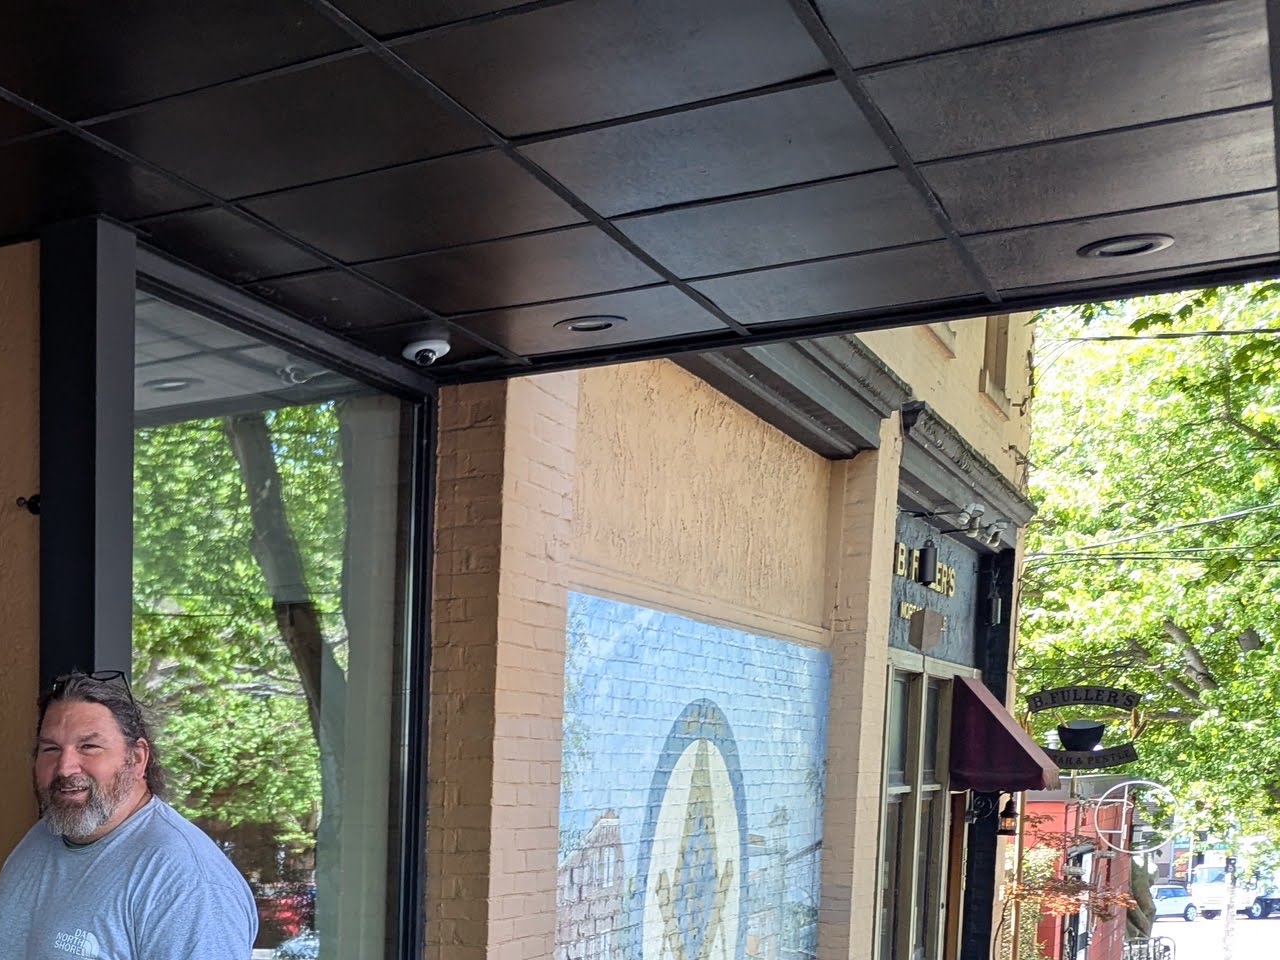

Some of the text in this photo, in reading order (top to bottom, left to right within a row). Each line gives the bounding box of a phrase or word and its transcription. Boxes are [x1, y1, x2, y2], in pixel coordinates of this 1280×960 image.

[1049, 687, 1136, 708] FULLER'S
[1087, 749, 1131, 765] PESTLE
[55, 932, 85, 947] NORTH
[74, 928, 86, 940] DA
[53, 940, 82, 956] SHORE
